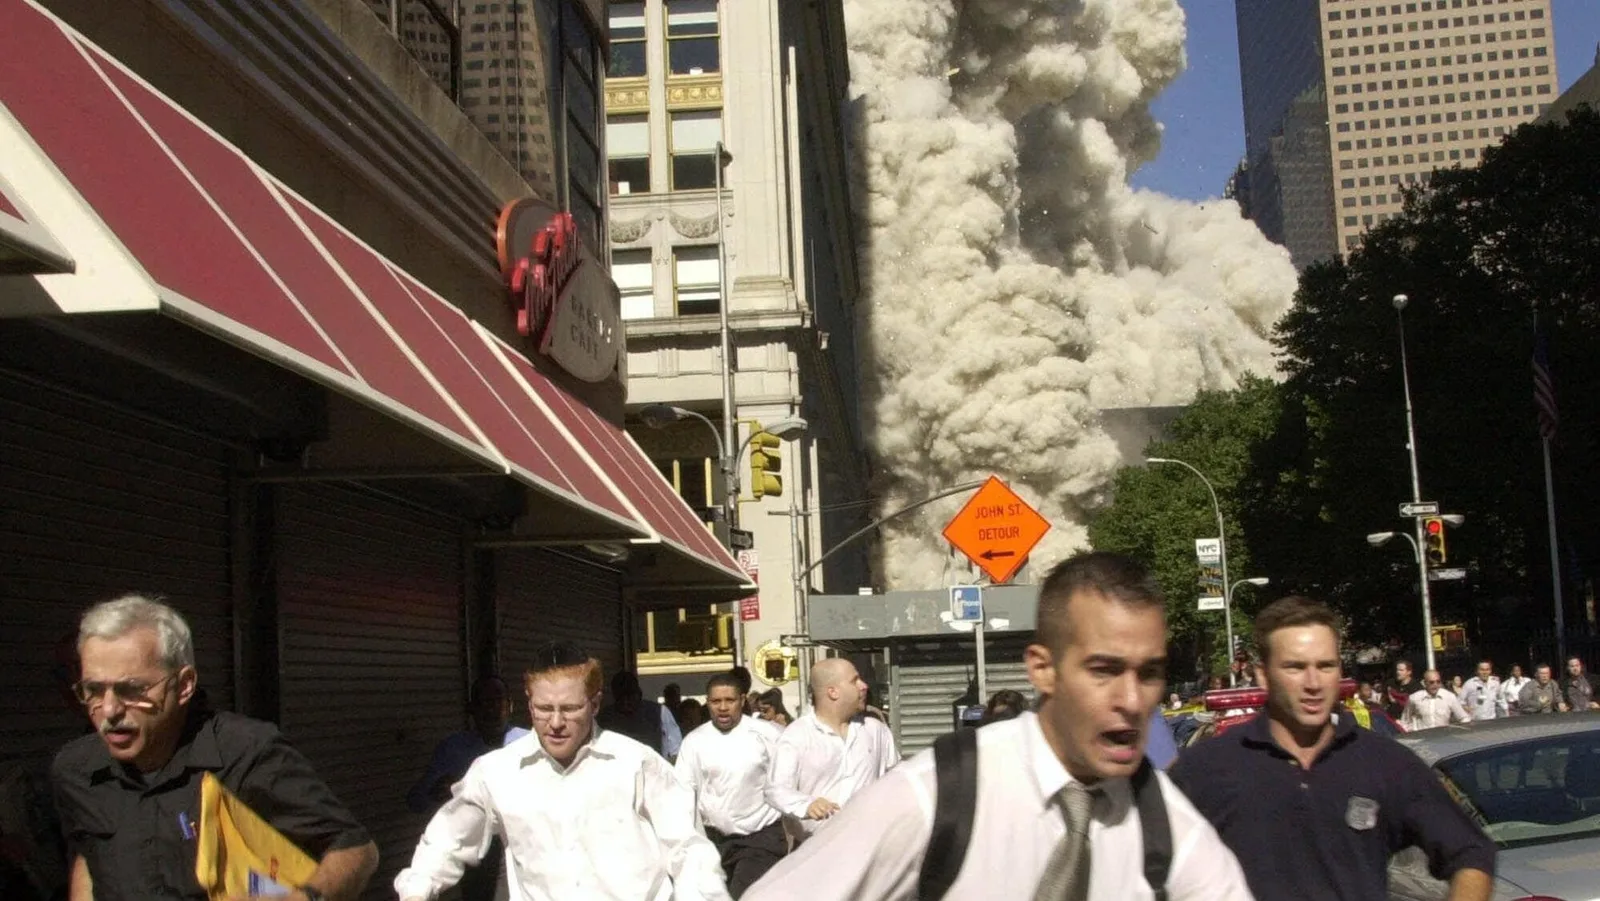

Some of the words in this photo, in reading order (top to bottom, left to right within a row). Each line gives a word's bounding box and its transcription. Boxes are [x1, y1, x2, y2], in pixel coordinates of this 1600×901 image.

[975, 505, 1004, 519] JOHN
[979, 526, 1020, 541] DETOUR
[1198, 544, 1217, 553] NYC
